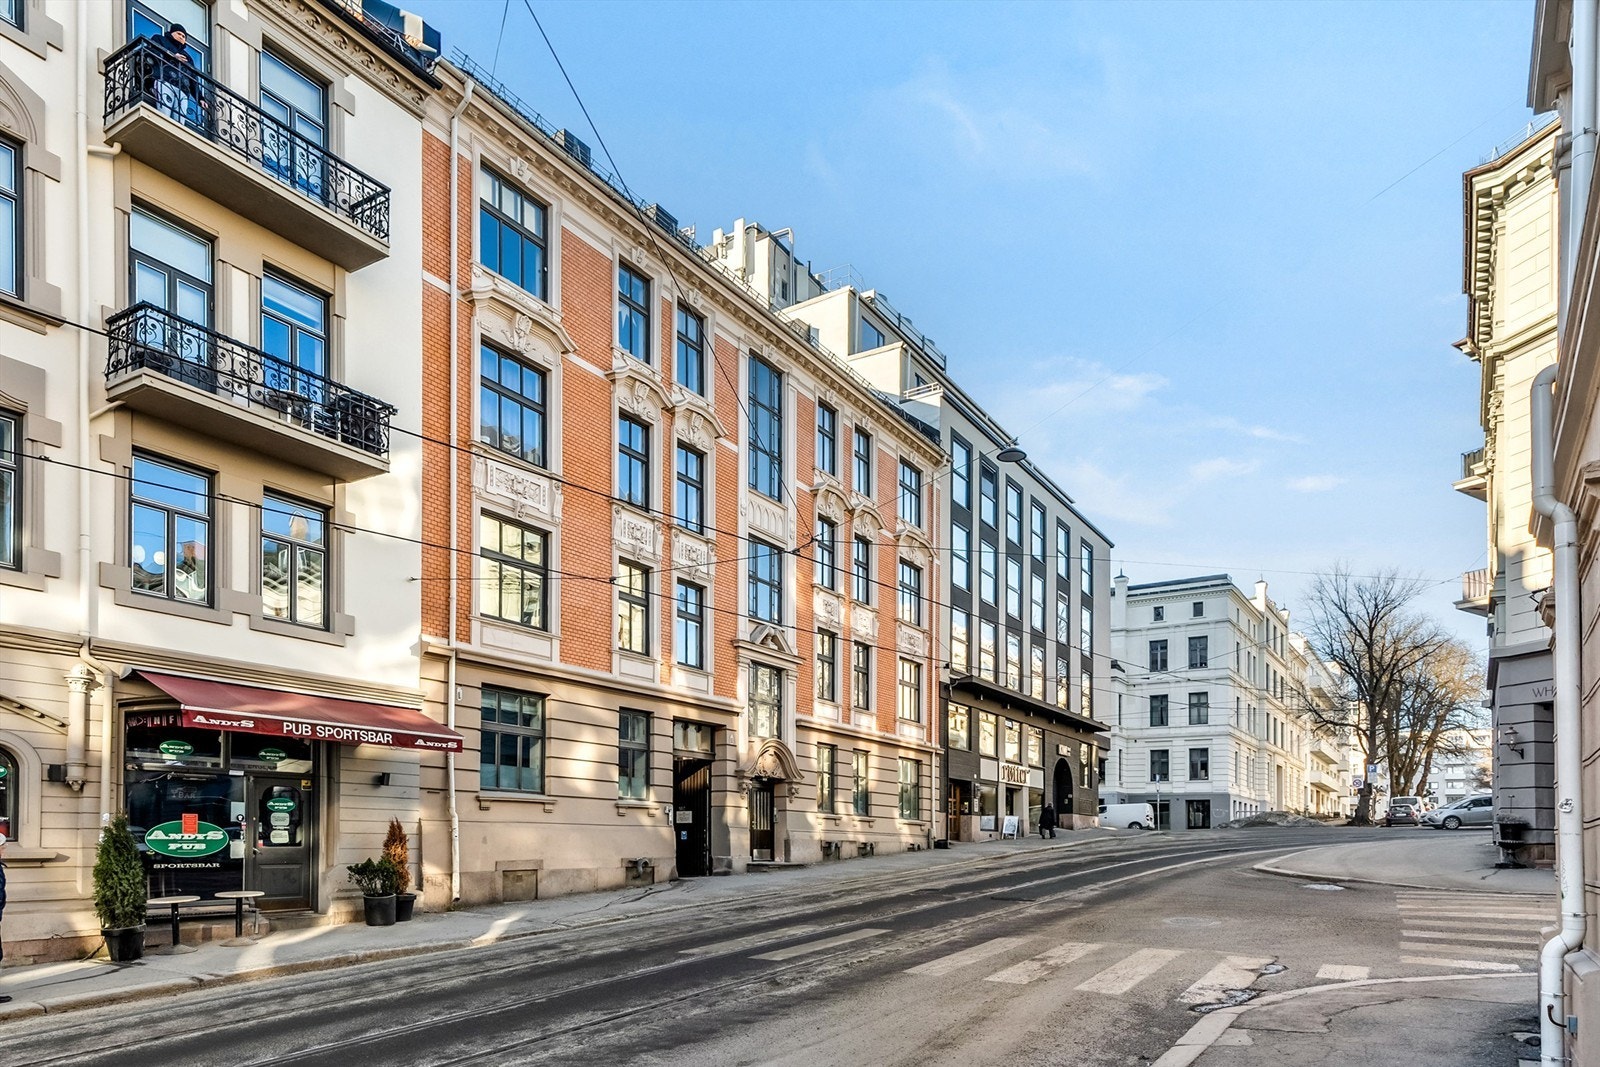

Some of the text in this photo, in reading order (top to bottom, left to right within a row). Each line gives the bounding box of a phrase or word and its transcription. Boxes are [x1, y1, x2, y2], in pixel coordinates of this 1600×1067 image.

[283, 722, 393, 744] PUB SPORTSBAR
[167, 842, 207, 850] PUB
